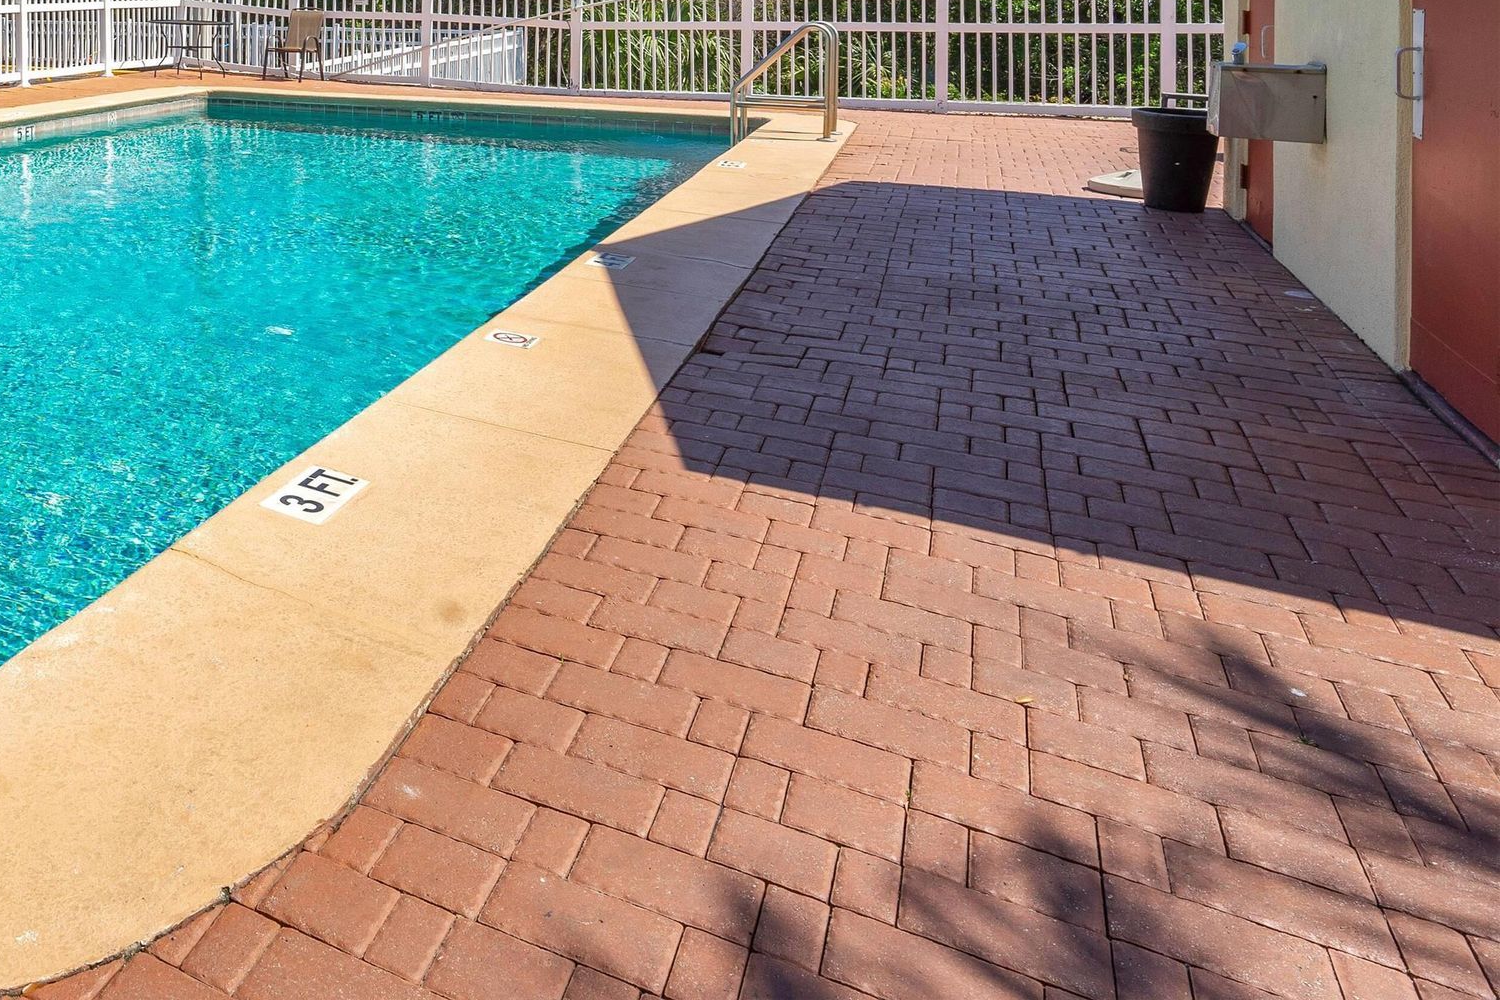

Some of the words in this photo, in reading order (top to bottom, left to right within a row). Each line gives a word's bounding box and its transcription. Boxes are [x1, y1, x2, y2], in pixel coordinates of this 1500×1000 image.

[17, 127, 23, 141] 5
[25, 125, 35, 142] FT
[279, 494, 325, 514] 3
